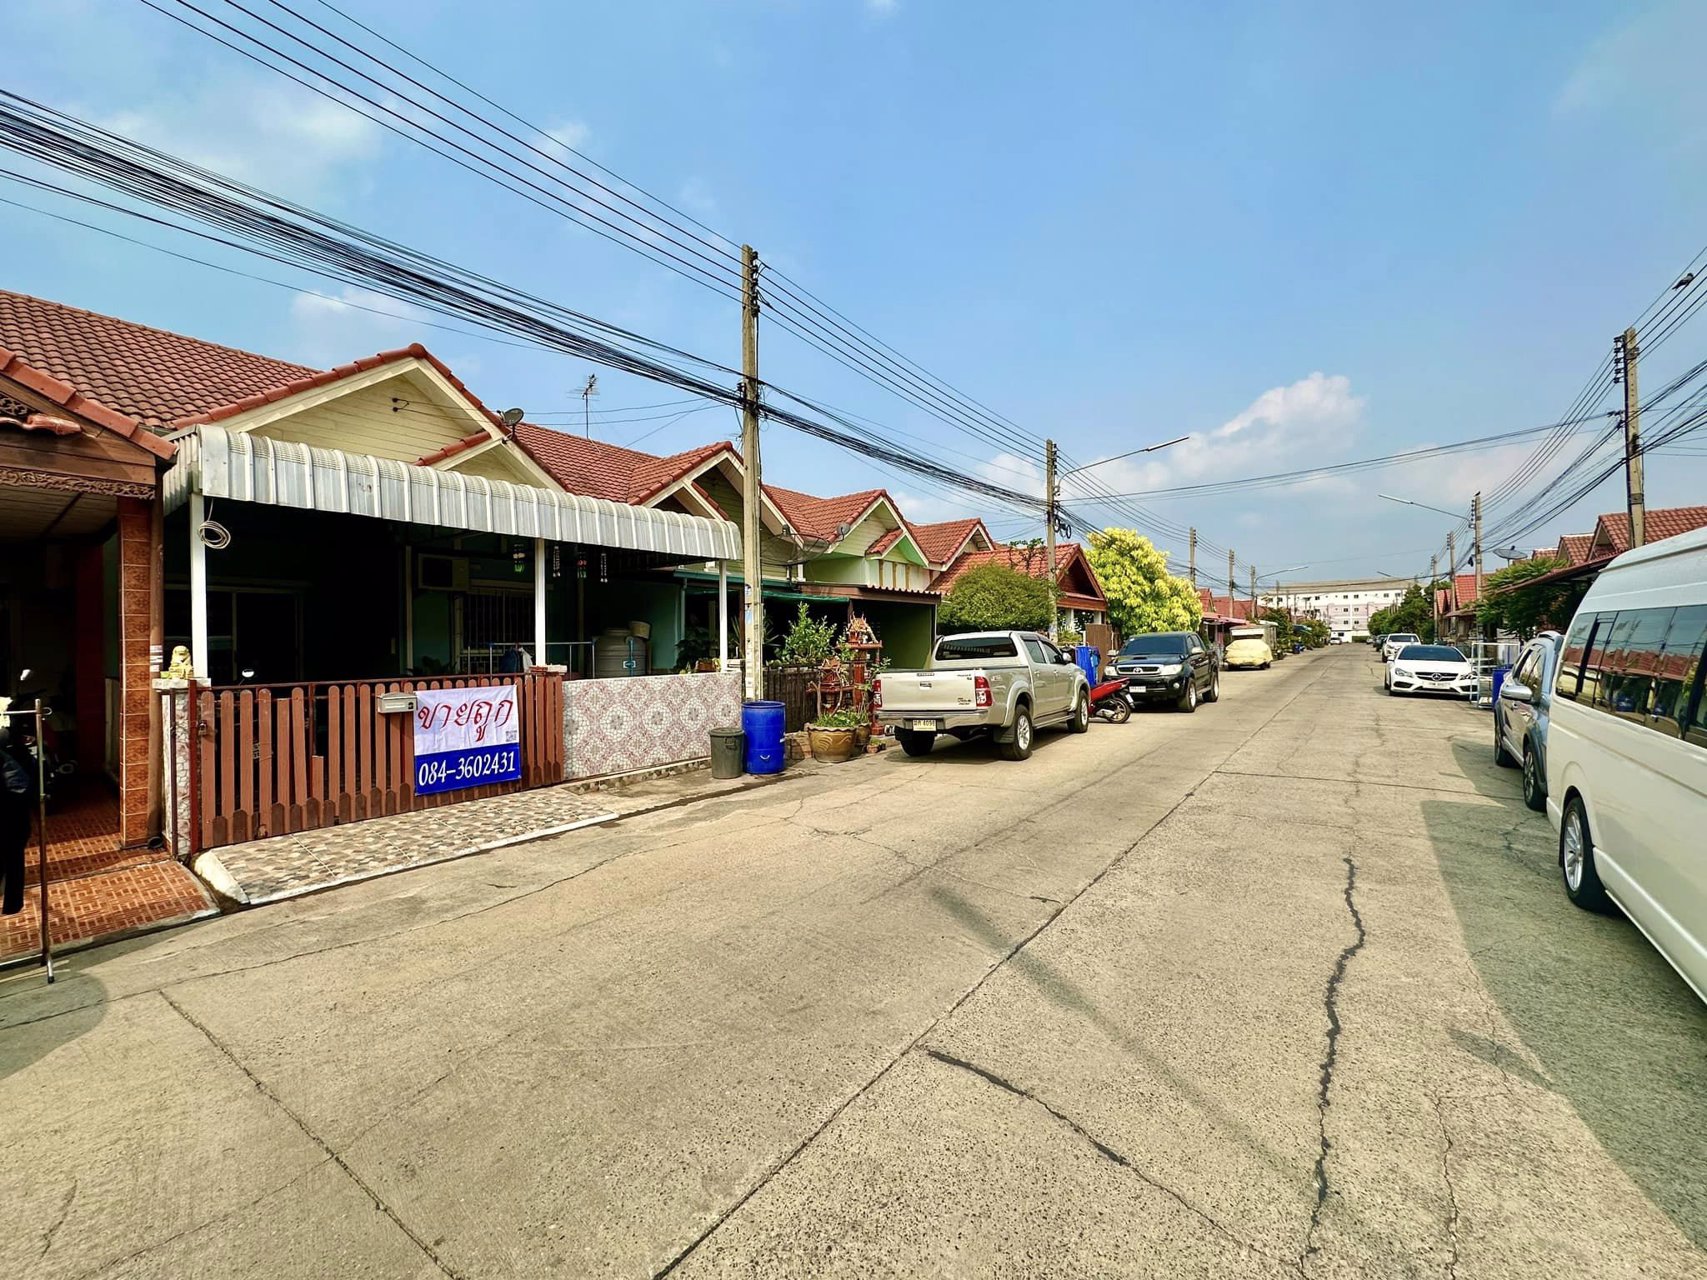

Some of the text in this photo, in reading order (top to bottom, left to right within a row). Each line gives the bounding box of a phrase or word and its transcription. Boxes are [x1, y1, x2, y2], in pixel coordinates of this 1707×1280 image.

[417, 699, 514, 742] ขายถูก
[418, 751, 516, 786] 084-3602431
